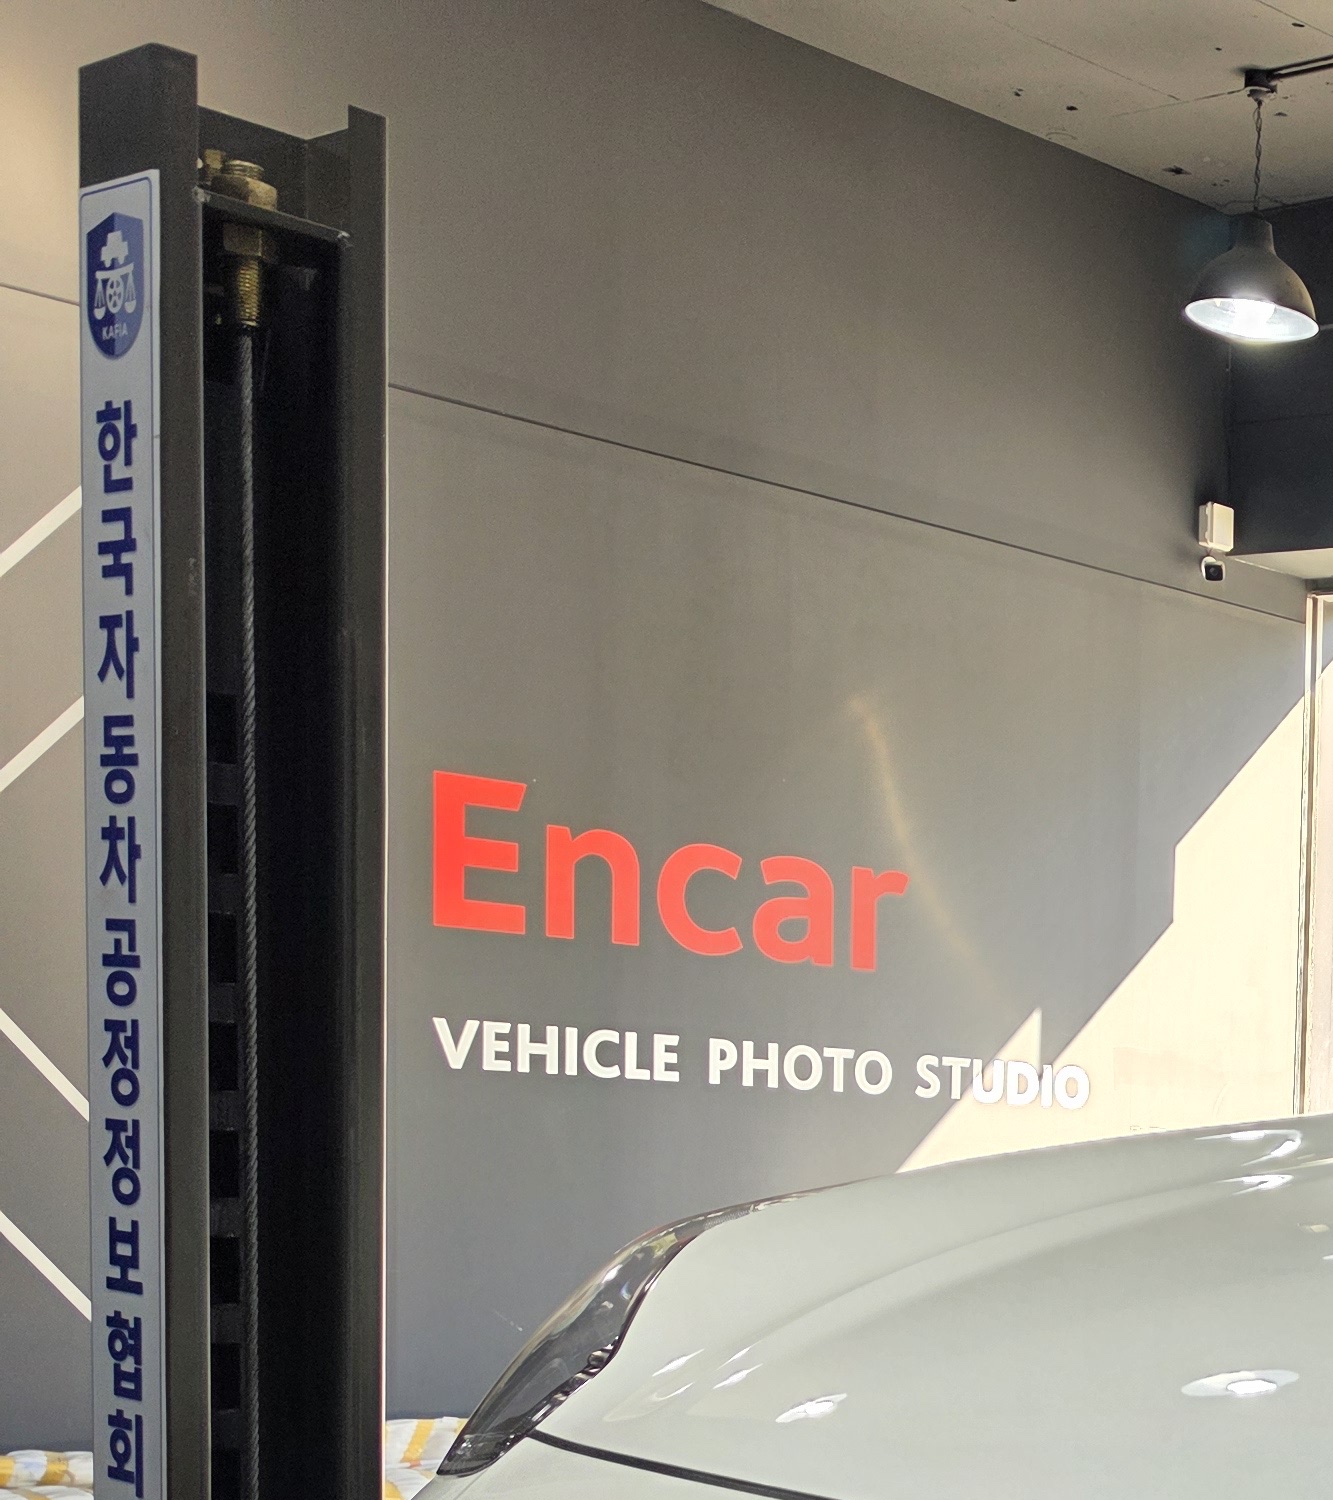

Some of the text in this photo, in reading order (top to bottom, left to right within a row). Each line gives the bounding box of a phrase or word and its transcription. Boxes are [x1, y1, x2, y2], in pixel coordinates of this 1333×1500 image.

[102, 323, 128, 341] KAFIA
[433, 770, 910, 972] Encar
[96, 399, 144, 1498] 한국자동차공정정보협회
[432, 1016, 1091, 1110] VEHICLE PHOTO STUDIO
